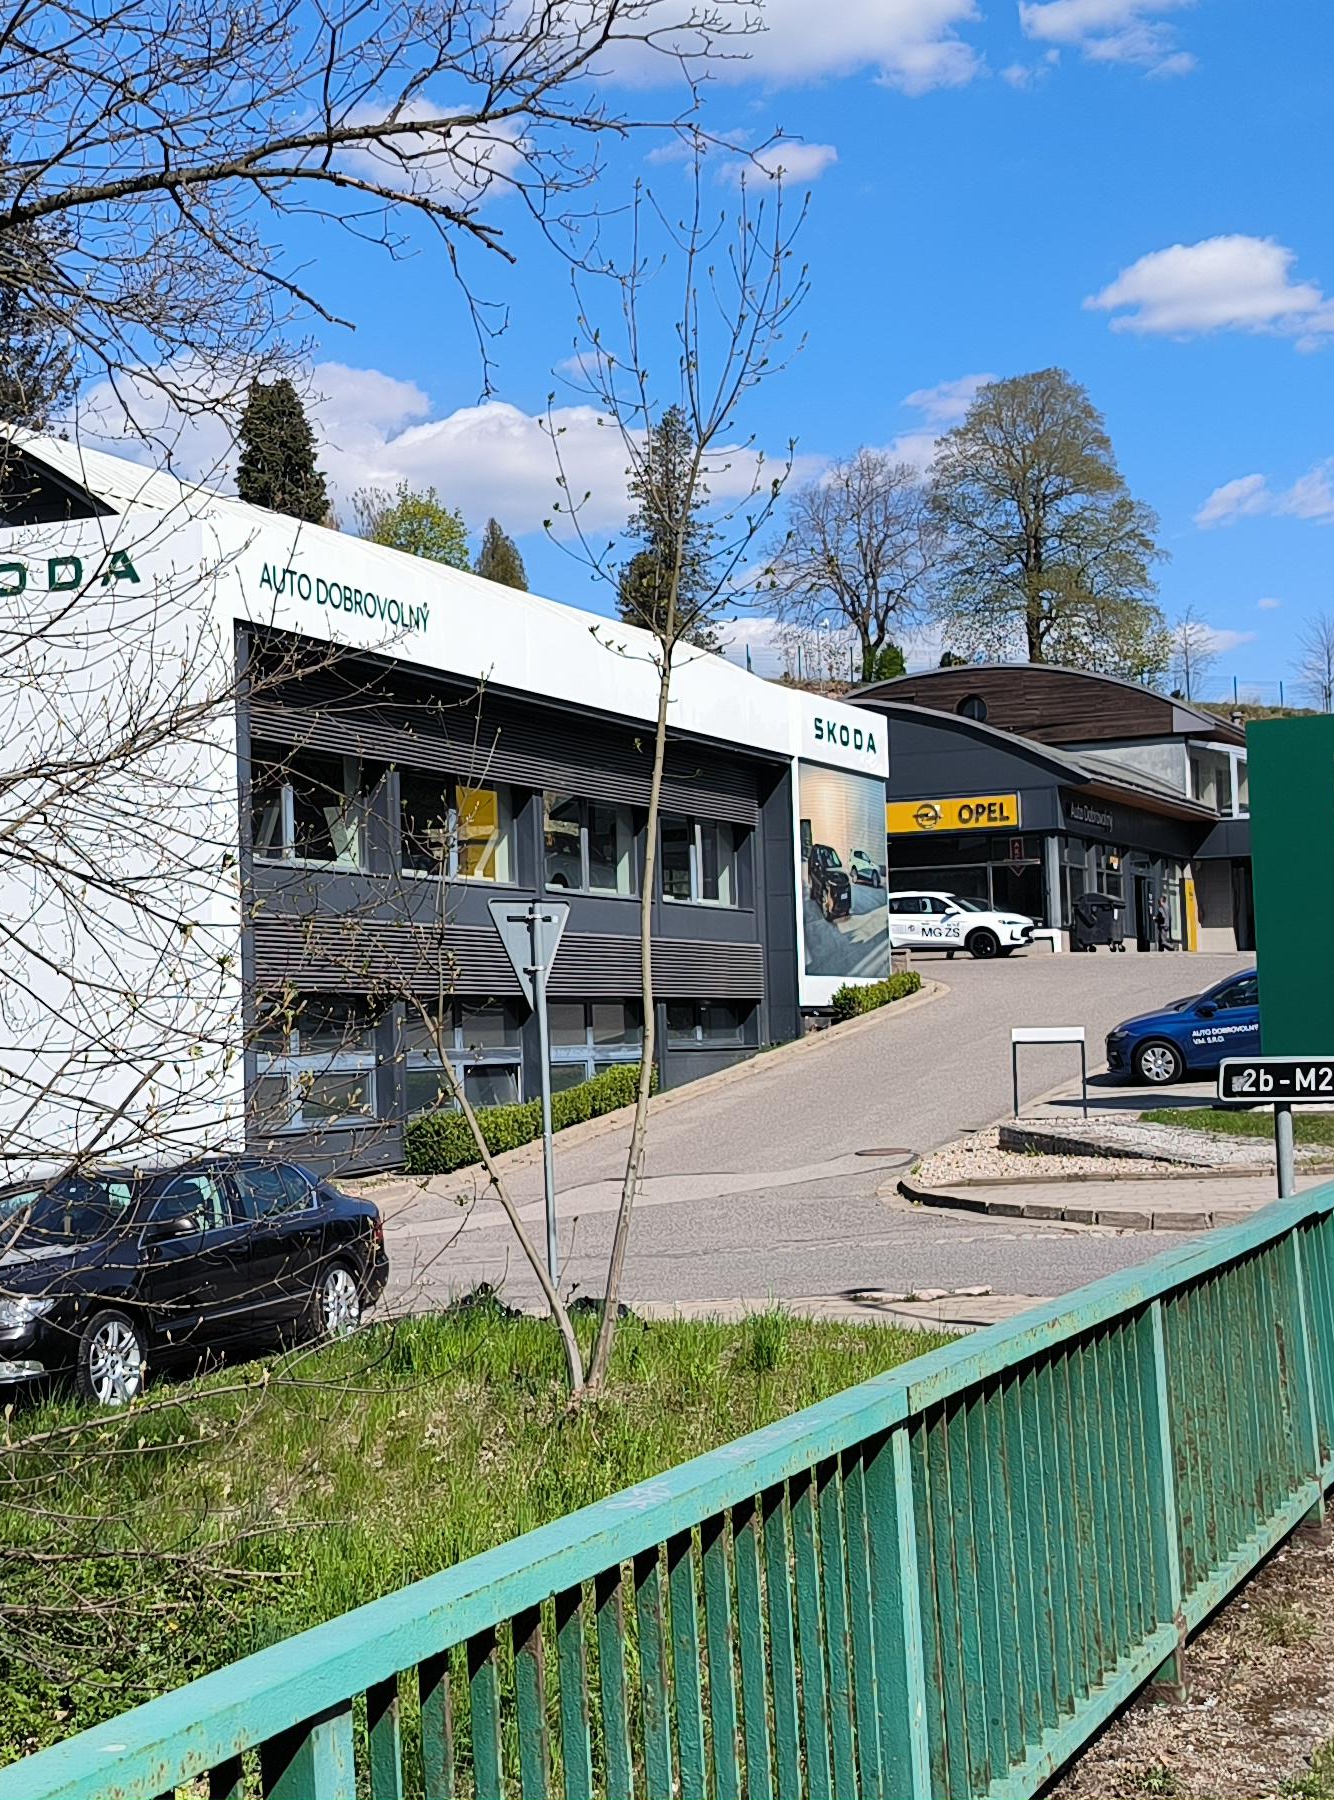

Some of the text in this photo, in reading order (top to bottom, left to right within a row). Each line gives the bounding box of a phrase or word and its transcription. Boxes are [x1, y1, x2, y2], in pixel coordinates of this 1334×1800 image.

[259, 562, 430, 633] AUTO DOBROVOLNÝ
[813, 717, 877, 755] SKODA
[957, 802, 1010, 824] OPEL
[921, 927, 943, 938] MG
[944, 927, 960, 938] ZS
[1192, 1029, 1212, 1037] AUTO
